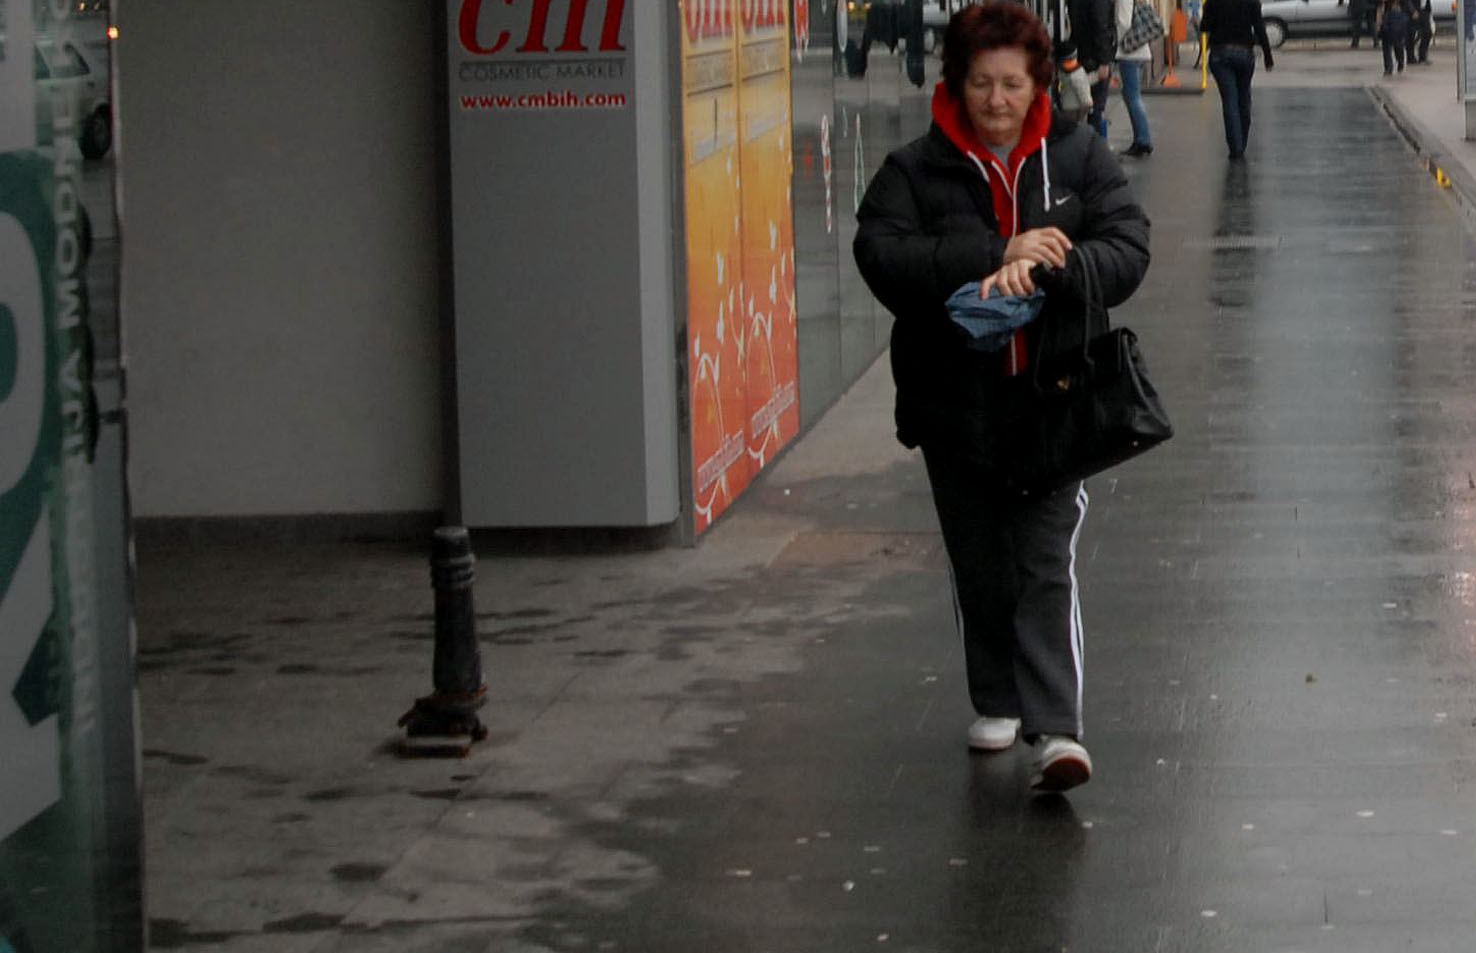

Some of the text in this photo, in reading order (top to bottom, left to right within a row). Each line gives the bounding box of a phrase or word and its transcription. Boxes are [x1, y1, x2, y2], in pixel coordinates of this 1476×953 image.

[458, 62, 625, 83] COSMETIC MARKET
[460, 90, 627, 109] www.cmbih.com
